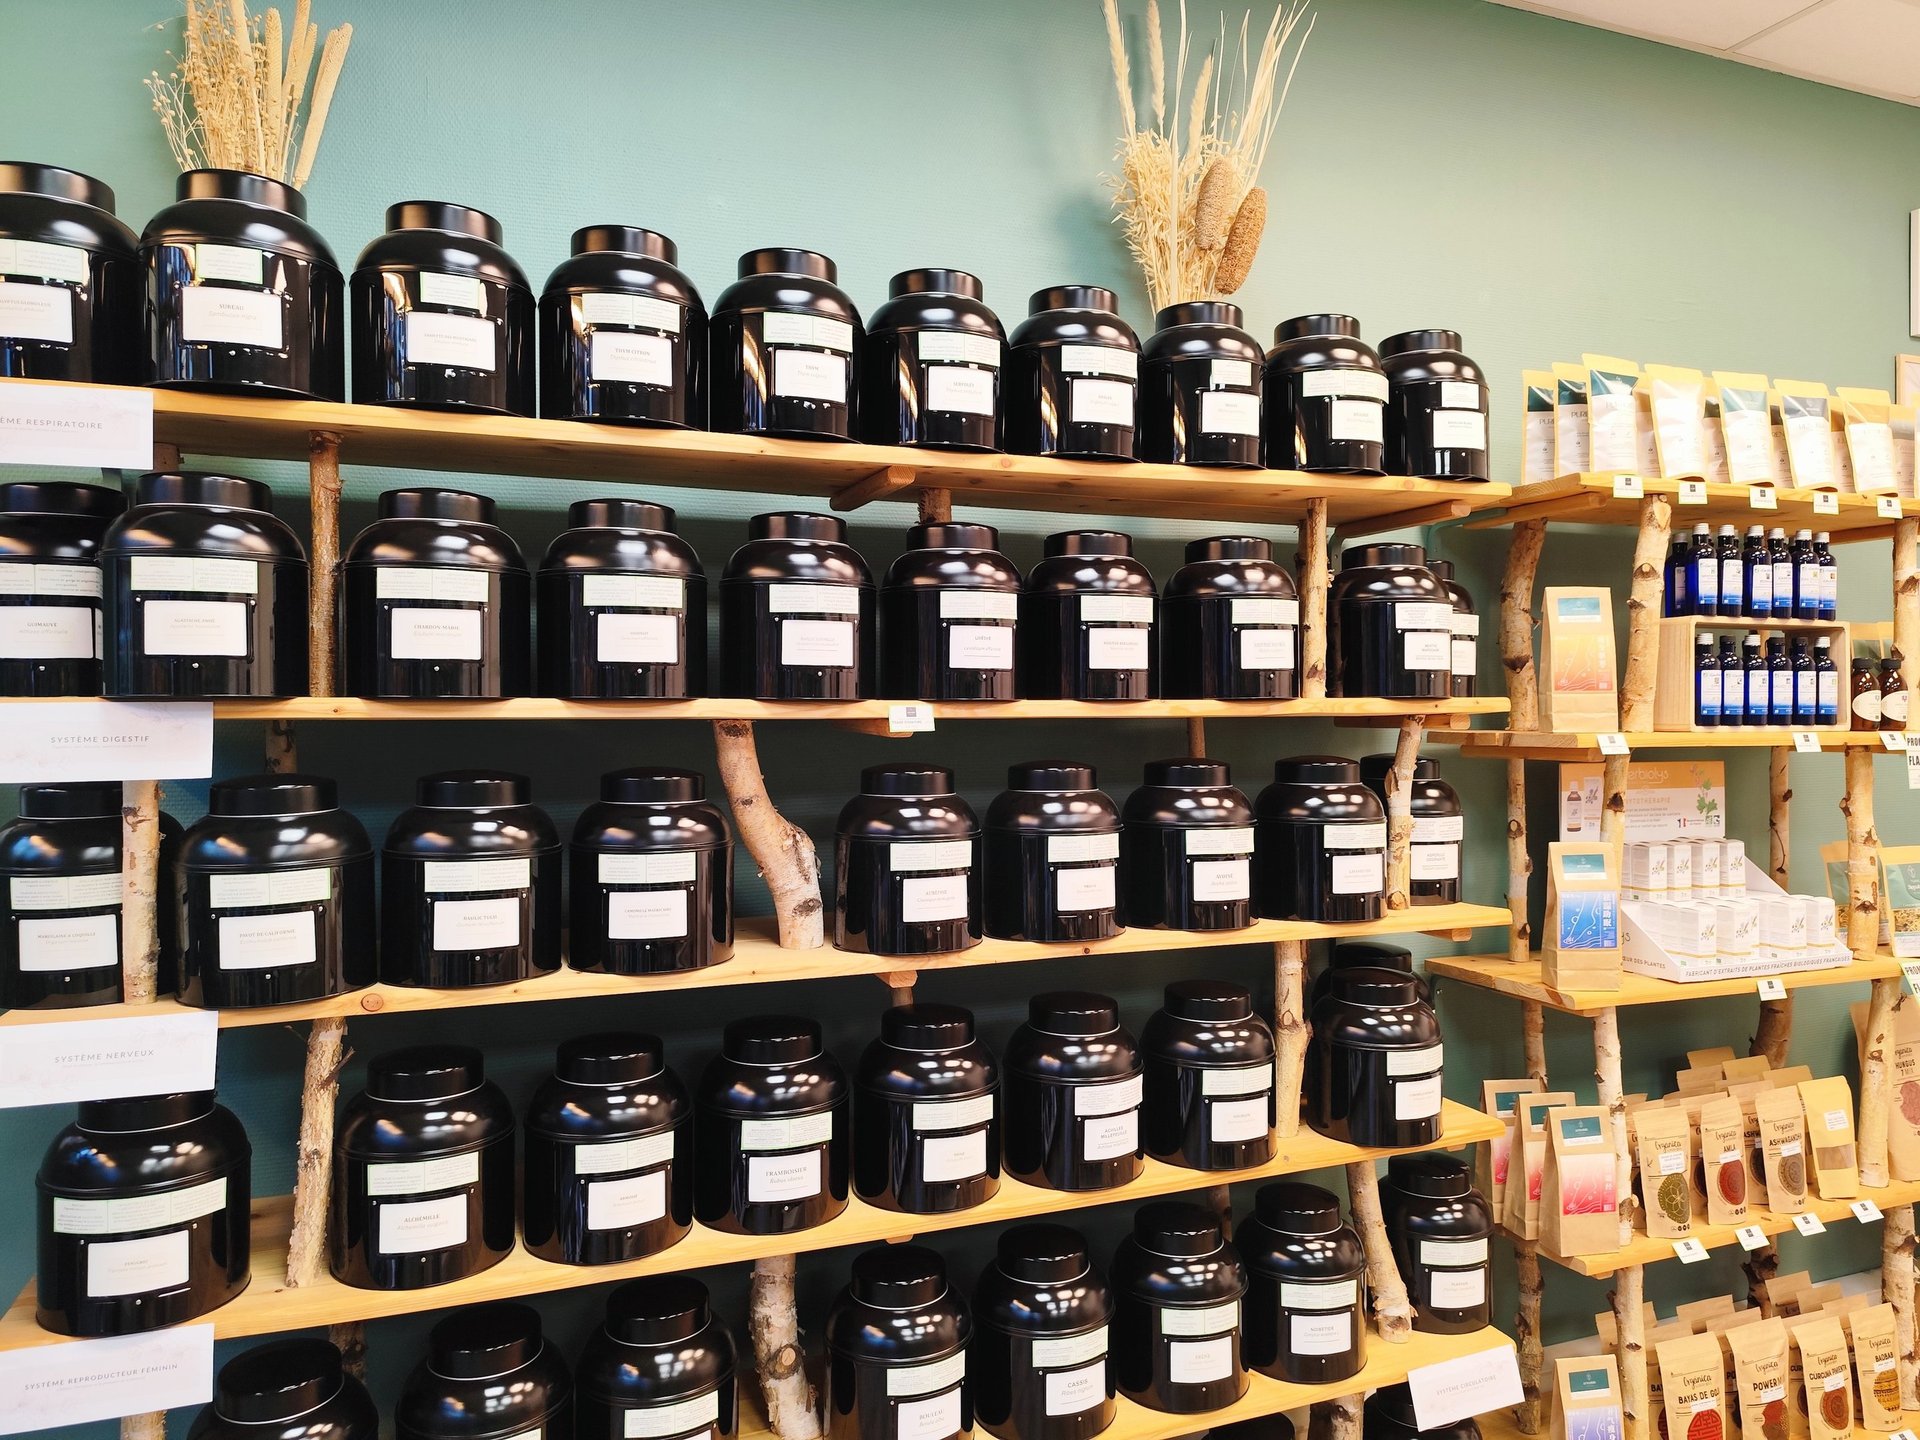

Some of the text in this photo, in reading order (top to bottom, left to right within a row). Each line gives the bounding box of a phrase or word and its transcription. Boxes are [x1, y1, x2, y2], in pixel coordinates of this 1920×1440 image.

[26, 418, 103, 430] RESPIRATOIRE
[51, 735, 150, 744] SYSTÈME DIGESTIF
[1644, 959, 1666, 969] PLANTES
[1686, 969, 1712, 977] FABRICANT
[1749, 964, 1770, 972] PLANTES
[1793, 959, 1823, 969] BIOLOGIQUES
[54, 1049, 155, 1064] SYSTÈME NERVEUX
[766, 1166, 807, 1176] FRAMBOISIER
[1875, 1351, 1894, 1362] BAOBAB
[68, 1369, 138, 1385] REPRODUCTEUR
[141, 1363, 178, 1374] FÉMININ
[1067, 1378, 1088, 1388] CASSIS
[1460, 1375, 1497, 1389] CIRCULATOIRE
[1752, 1379, 1777, 1391] POWER
[1678, 1393, 1698, 1405] BAYAS
[1699, 1391, 1709, 1400] DE
